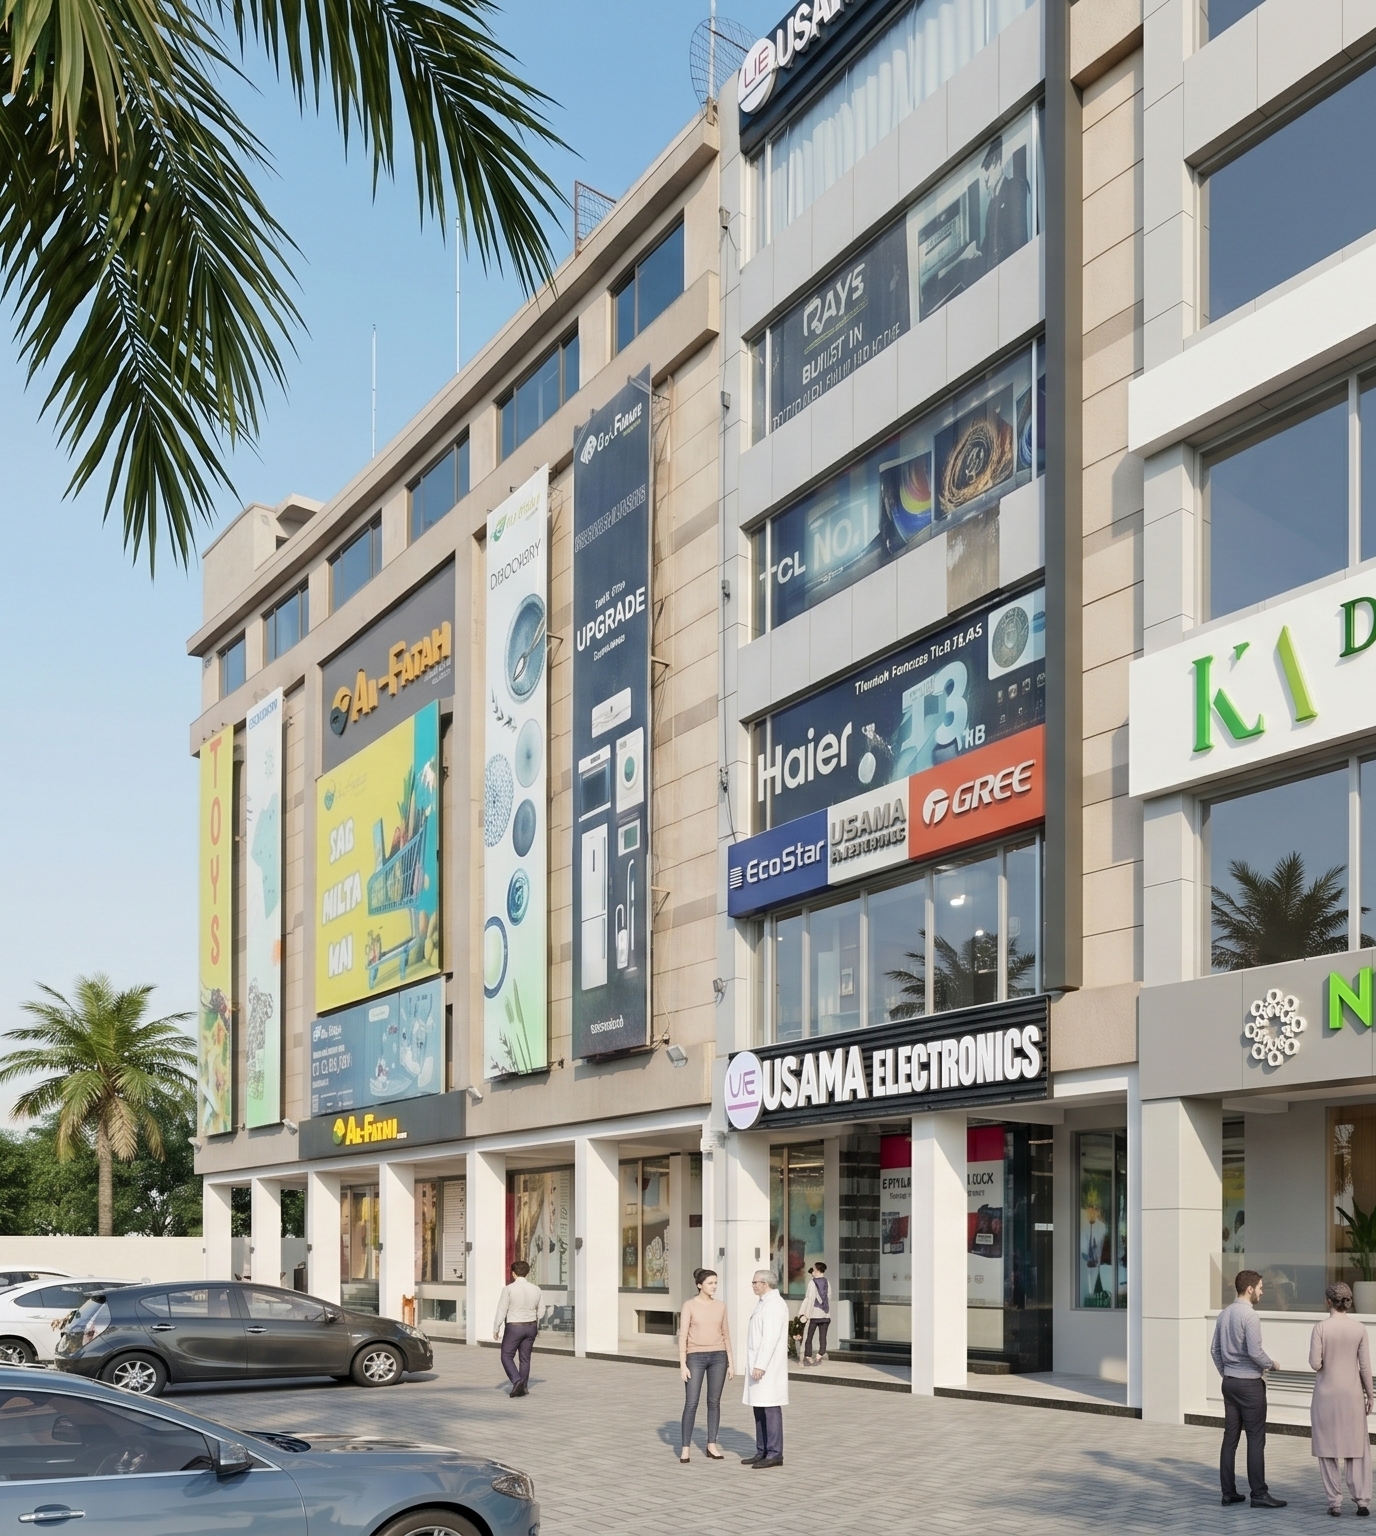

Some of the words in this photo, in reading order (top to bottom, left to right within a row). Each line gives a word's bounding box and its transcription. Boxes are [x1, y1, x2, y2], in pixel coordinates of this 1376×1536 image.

[777, 0, 842, 67] USA
[577, 586, 646, 652] UPGRADE
[757, 721, 852, 803] Haier
[952, 760, 1035, 815] GREE
[209, 735, 223, 966] TOYS
[830, 798, 907, 846] USAMA
[746, 840, 826, 883] EcoStar
[762, 1045, 868, 1111] USAMA
[872, 1025, 1042, 1098] ELECTRONICS
